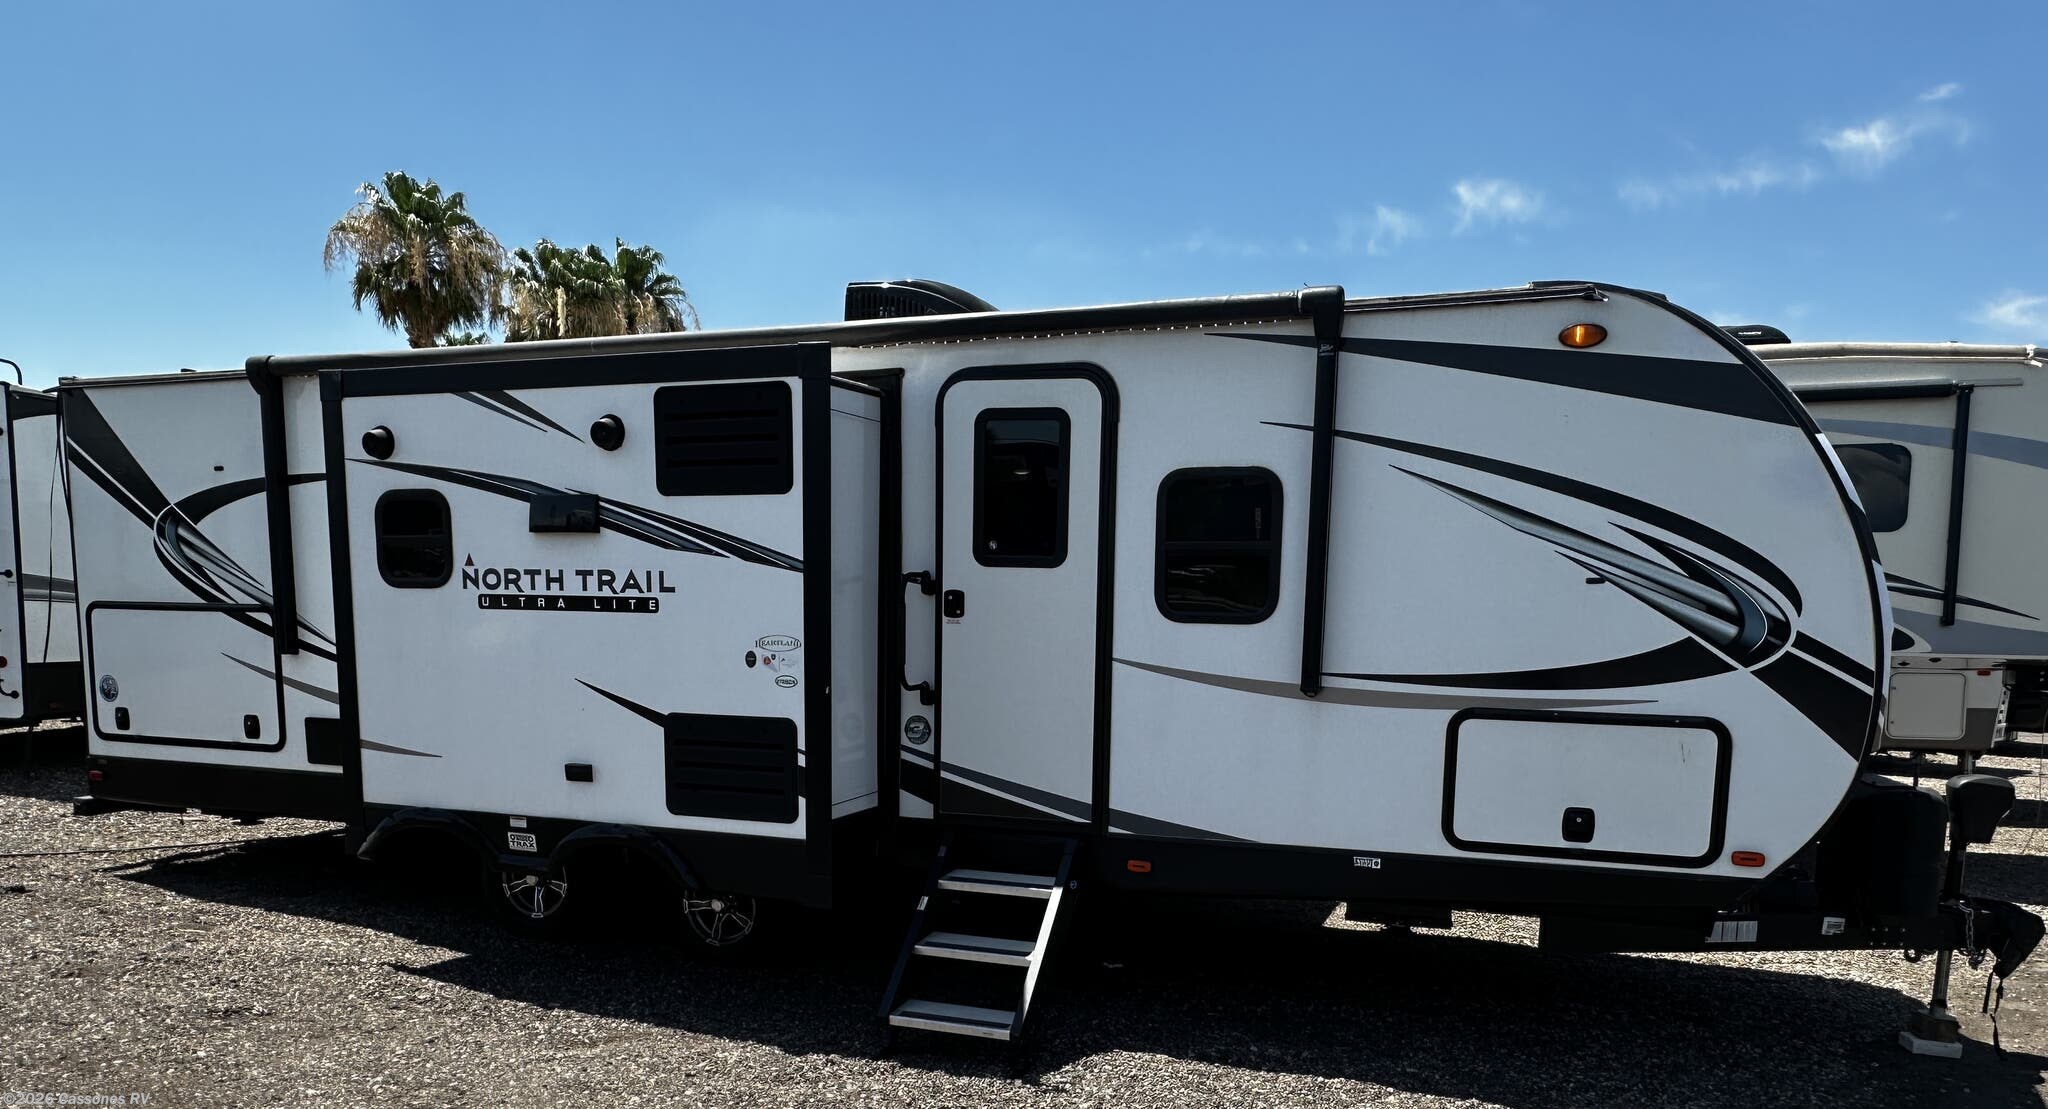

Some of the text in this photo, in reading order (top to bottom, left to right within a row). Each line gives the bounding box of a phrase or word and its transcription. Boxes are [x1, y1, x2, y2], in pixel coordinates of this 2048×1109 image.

[462, 567, 676, 594] NORTH TRAIL
[481, 597, 656, 610] ULTRA LITE
